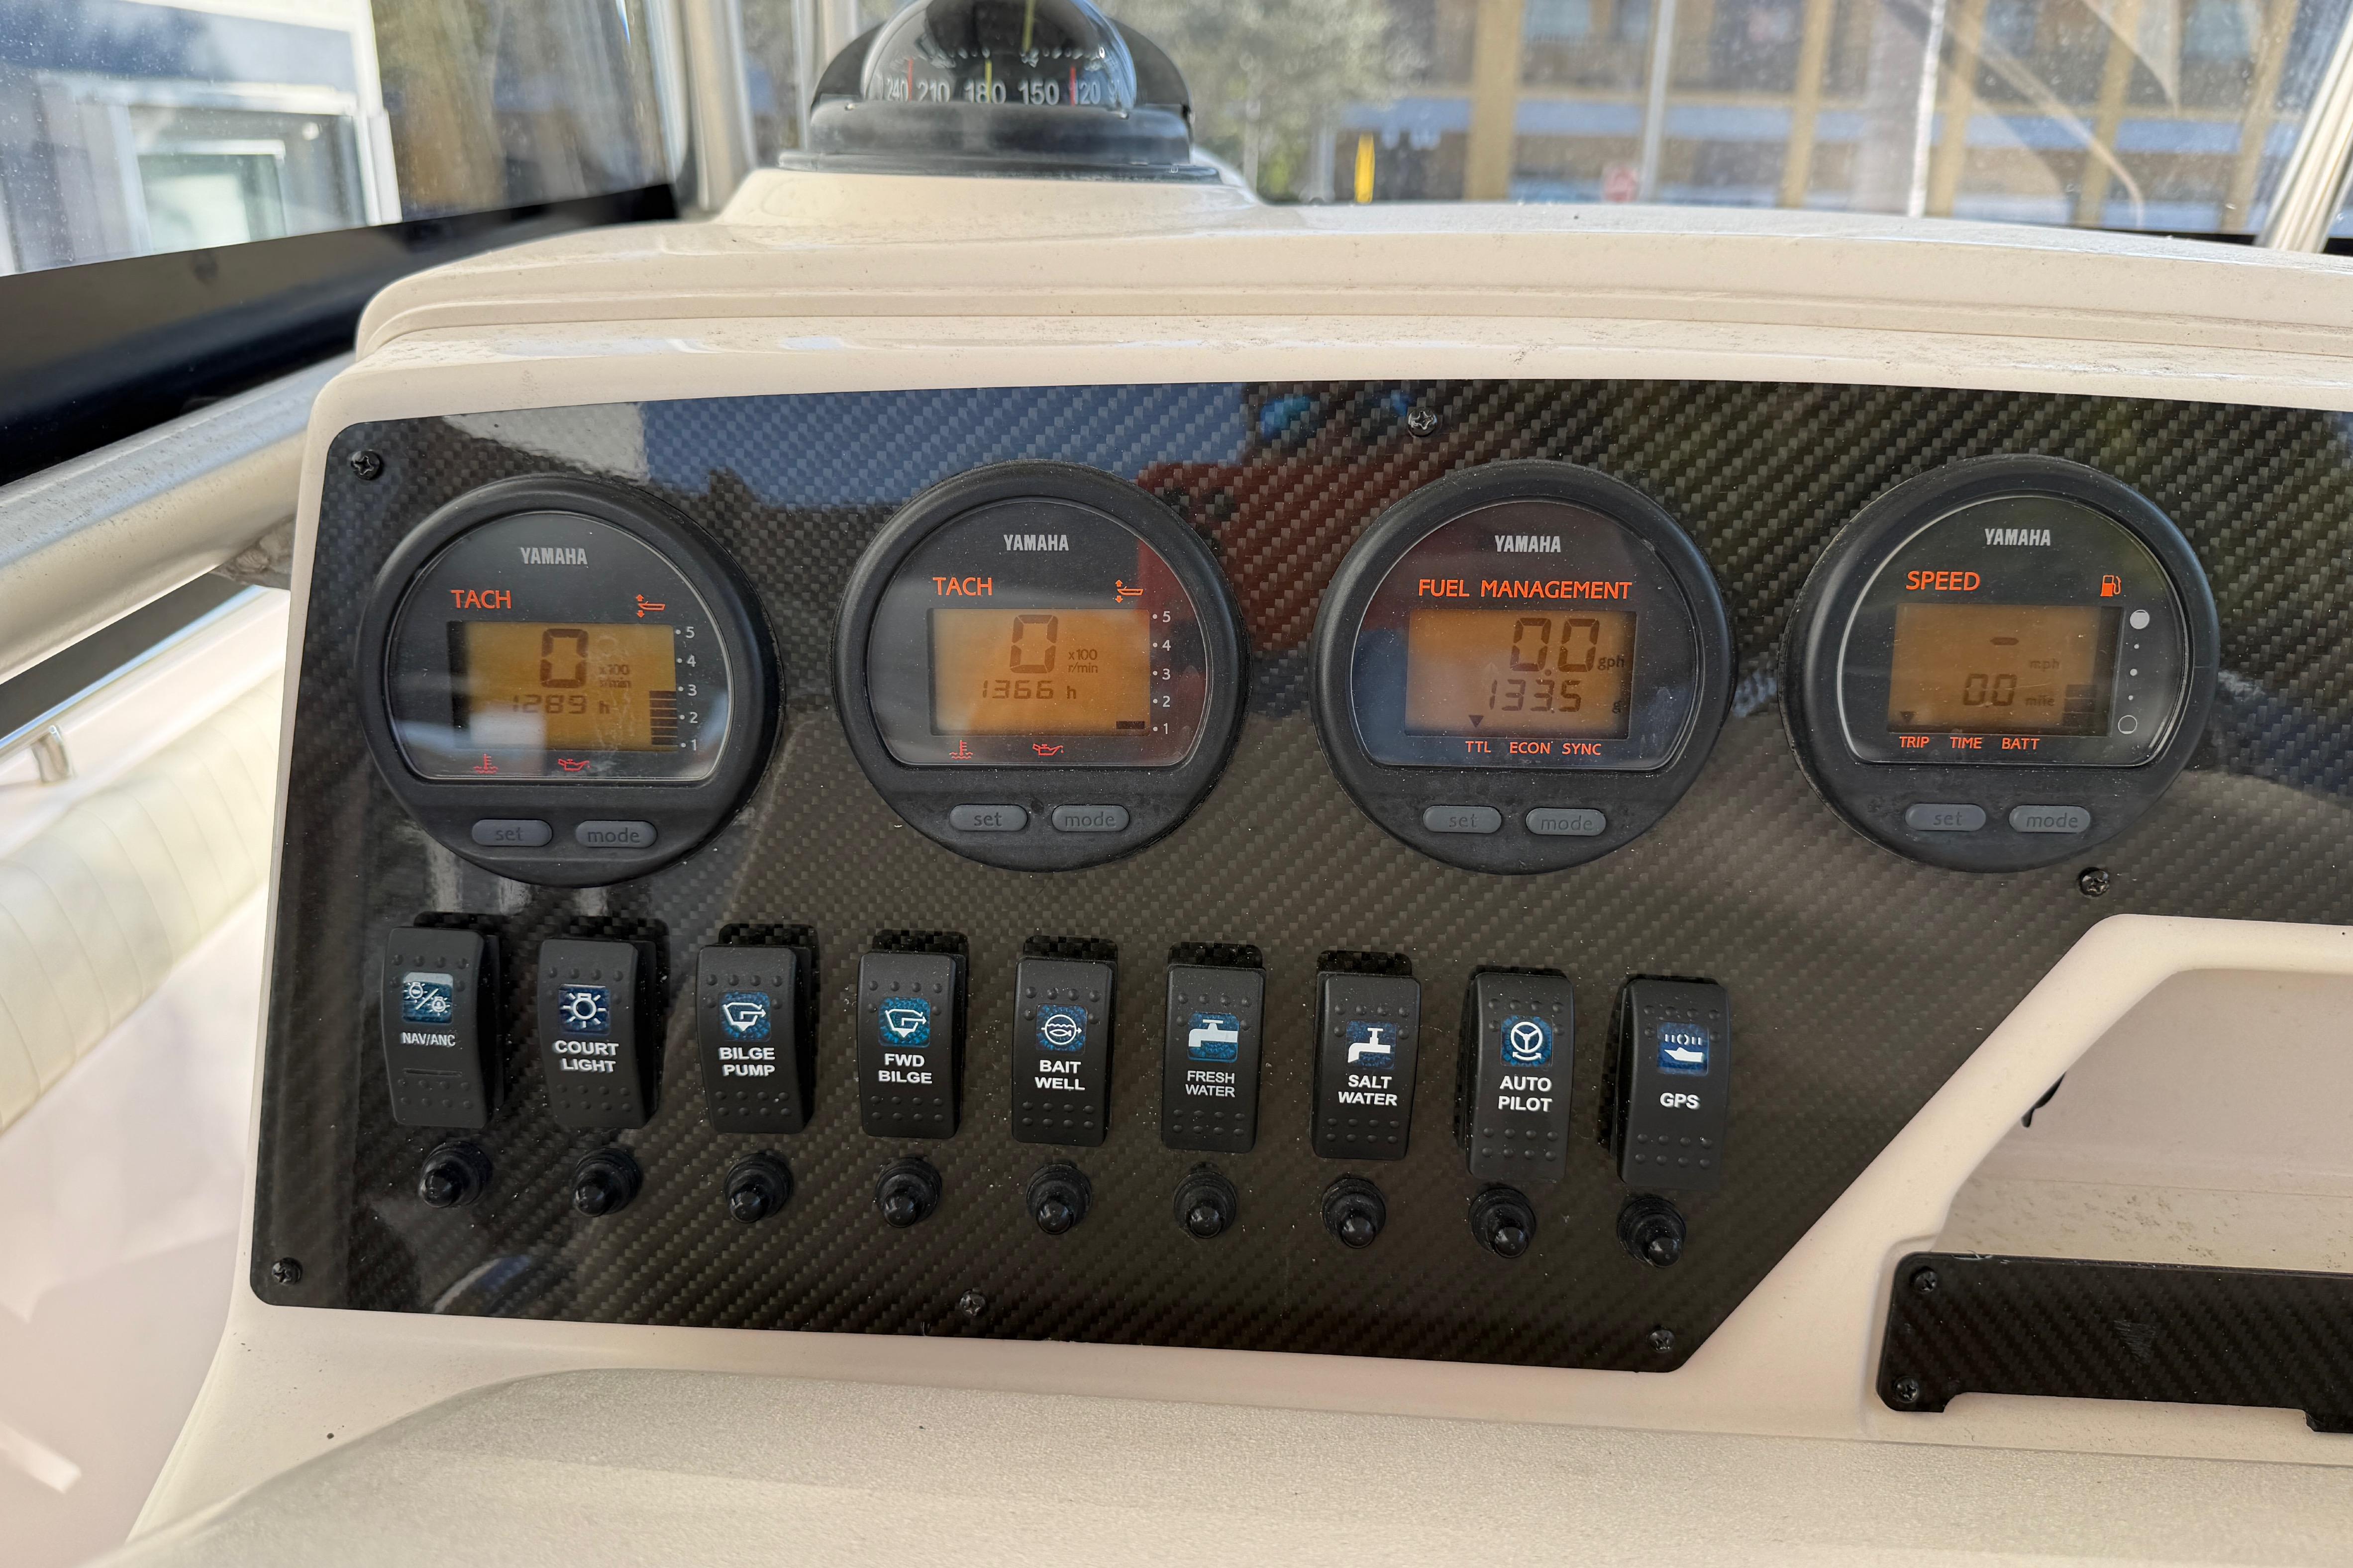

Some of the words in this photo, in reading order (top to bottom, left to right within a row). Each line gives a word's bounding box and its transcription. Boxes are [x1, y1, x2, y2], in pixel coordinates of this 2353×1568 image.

[916, 81, 950, 103] 210
[964, 78, 1006, 104] 180
[1018, 78, 1060, 105] 150
[1004, 535, 1069, 551] YAMAHA
[1495, 535, 1561, 553] YAMAHA
[1985, 528, 2051, 546] YAMAHA
[520, 547, 588, 565] YAMAHA
[933, 577, 993, 596] TACH
[1906, 571, 1980, 591] SPEED
[1419, 579, 1469, 597] FUEL
[1481, 580, 1632, 599] MANAGEMENT
[451, 589, 512, 609] TACH
[1162, 611, 1171, 623] 5
[686, 626, 695, 639] 5
[1010, 615, 1058, 674] 0
[1162, 639, 1171, 651] 4
[1510, 617, 1600, 676] 0.0
[1597, 655, 1625, 671] gph
[540, 628, 588, 688] 0
[687, 655, 696, 667] 4
[1068, 649, 1098, 661] x100
[1068, 662, 1098, 674] r/min
[2029, 658, 2059, 672] mph
[1162, 668, 1171, 680] 3
[688, 685, 697, 696] 3
[982, 680, 1054, 699] 1366
[1067, 686, 1077, 699] h
[512, 694, 588, 714] 1289
[599, 700, 610, 714] h
[1162, 696, 1171, 707] 2
[2026, 695, 2055, 706] mile
[690, 712, 698, 724] 2
[1163, 723, 1169, 734] 1
[691, 739, 697, 751] 1
[1465, 741, 1491, 754] TTL
[1509, 742, 1551, 755] ECON
[1562, 743, 1602, 756] SYNC
[1899, 737, 1930, 749] TRIP
[1950, 737, 1982, 749] TIME
[2001, 738, 2040, 751] BATT
[974, 811, 1003, 827] set
[1064, 811, 1116, 828] mode
[1448, 813, 1478, 828] set
[1540, 815, 1593, 831] mode
[1933, 810, 1963, 826] set
[2026, 812, 2079, 830] mode
[495, 826, 523, 842] set
[587, 827, 640, 844] mode
[401, 1032, 456, 1048] NAV/ANC
[553, 1040, 619, 1057] COURT
[718, 1047, 776, 1061] BILGE
[562, 1058, 616, 1074] LIGHT
[884, 1053, 925, 1068] FWD
[1039, 1060, 1082, 1075] BAIT
[722, 1064, 776, 1078] PUMP
[878, 1070, 932, 1085] BILGE
[1187, 1070, 1235, 1084] FRESH
[1034, 1077, 1086, 1091] WELL
[1348, 1075, 1392, 1090] SALT
[1500, 1076, 1552, 1092] AUTO
[1185, 1084, 1236, 1098] WATER
[1338, 1091, 1398, 1106] WATER
[1498, 1095, 1553, 1112] PILOT
[1660, 1092, 1701, 1110] GPS
